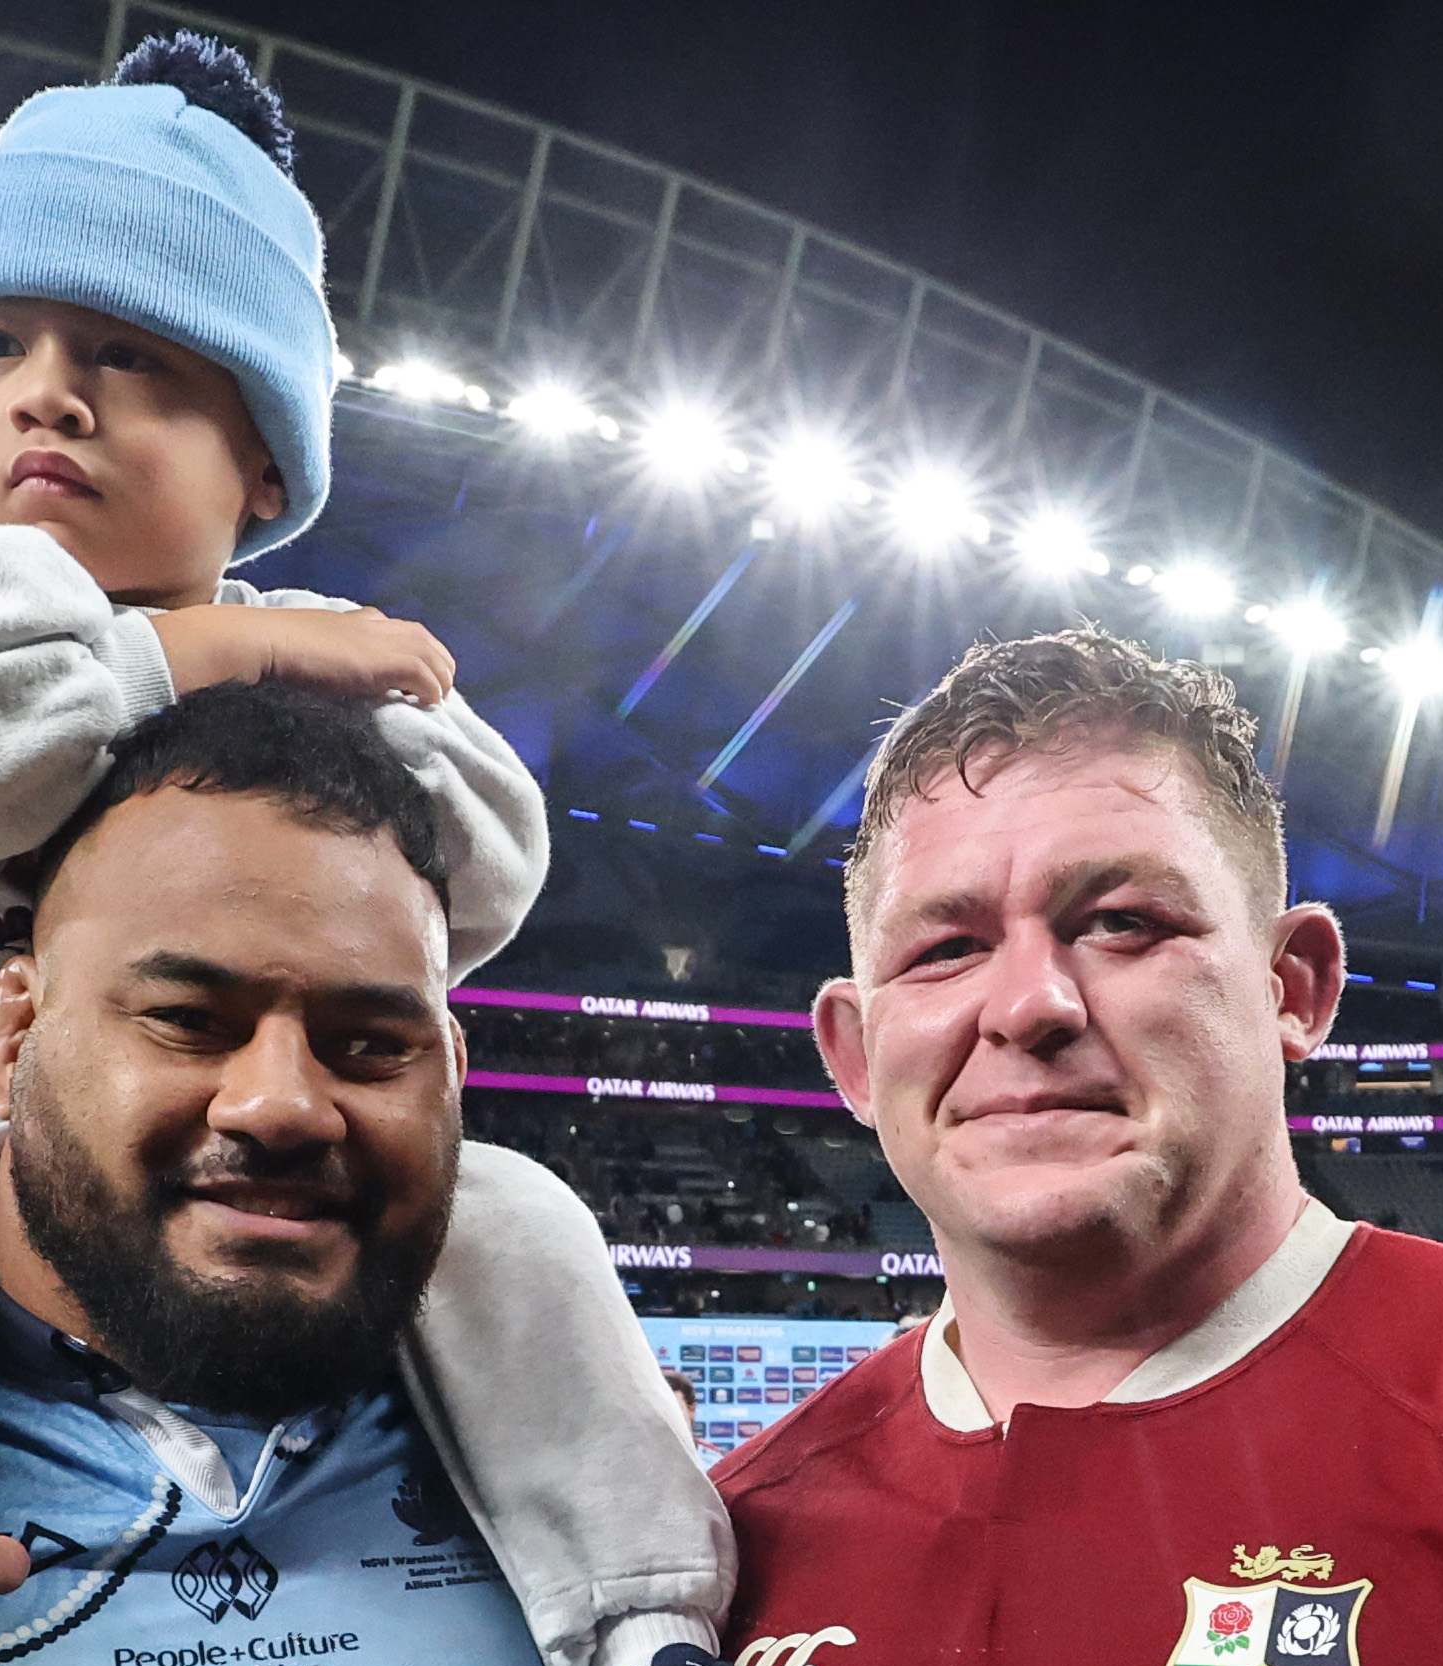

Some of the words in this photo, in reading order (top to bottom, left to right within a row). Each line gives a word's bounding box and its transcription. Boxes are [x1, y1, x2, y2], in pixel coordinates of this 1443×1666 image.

[580, 996, 638, 1017] QATAR
[640, 1000, 711, 1022] AIRWAYS
[1359, 1043, 1429, 1060] AIRWAYS
[586, 1077, 644, 1098] QATAR
[646, 1081, 716, 1102] AIRWAYS
[1311, 1115, 1364, 1133] QATAR
[1365, 1115, 1435, 1132] AIRWAYS
